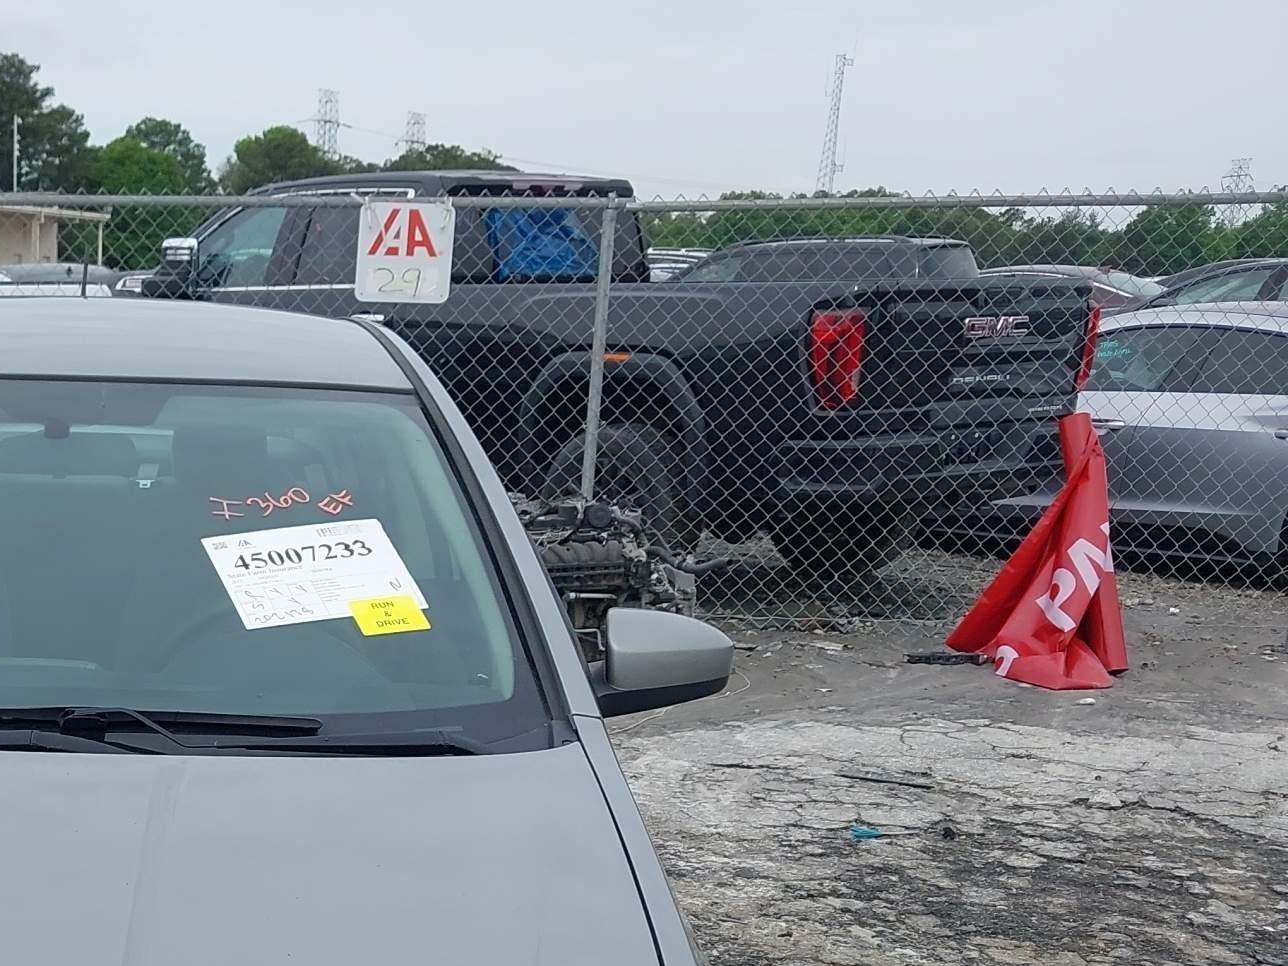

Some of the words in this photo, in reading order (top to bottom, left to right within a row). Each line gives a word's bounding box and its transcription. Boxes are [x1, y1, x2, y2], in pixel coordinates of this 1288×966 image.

[375, 267, 422, 297] 29
[964, 316, 1030, 337] GMC
[246, 487, 310, 516] 360
[234, 539, 373, 570] 45007233
[370, 601, 395, 610] RUN
[375, 618, 410, 628] DRIVE
